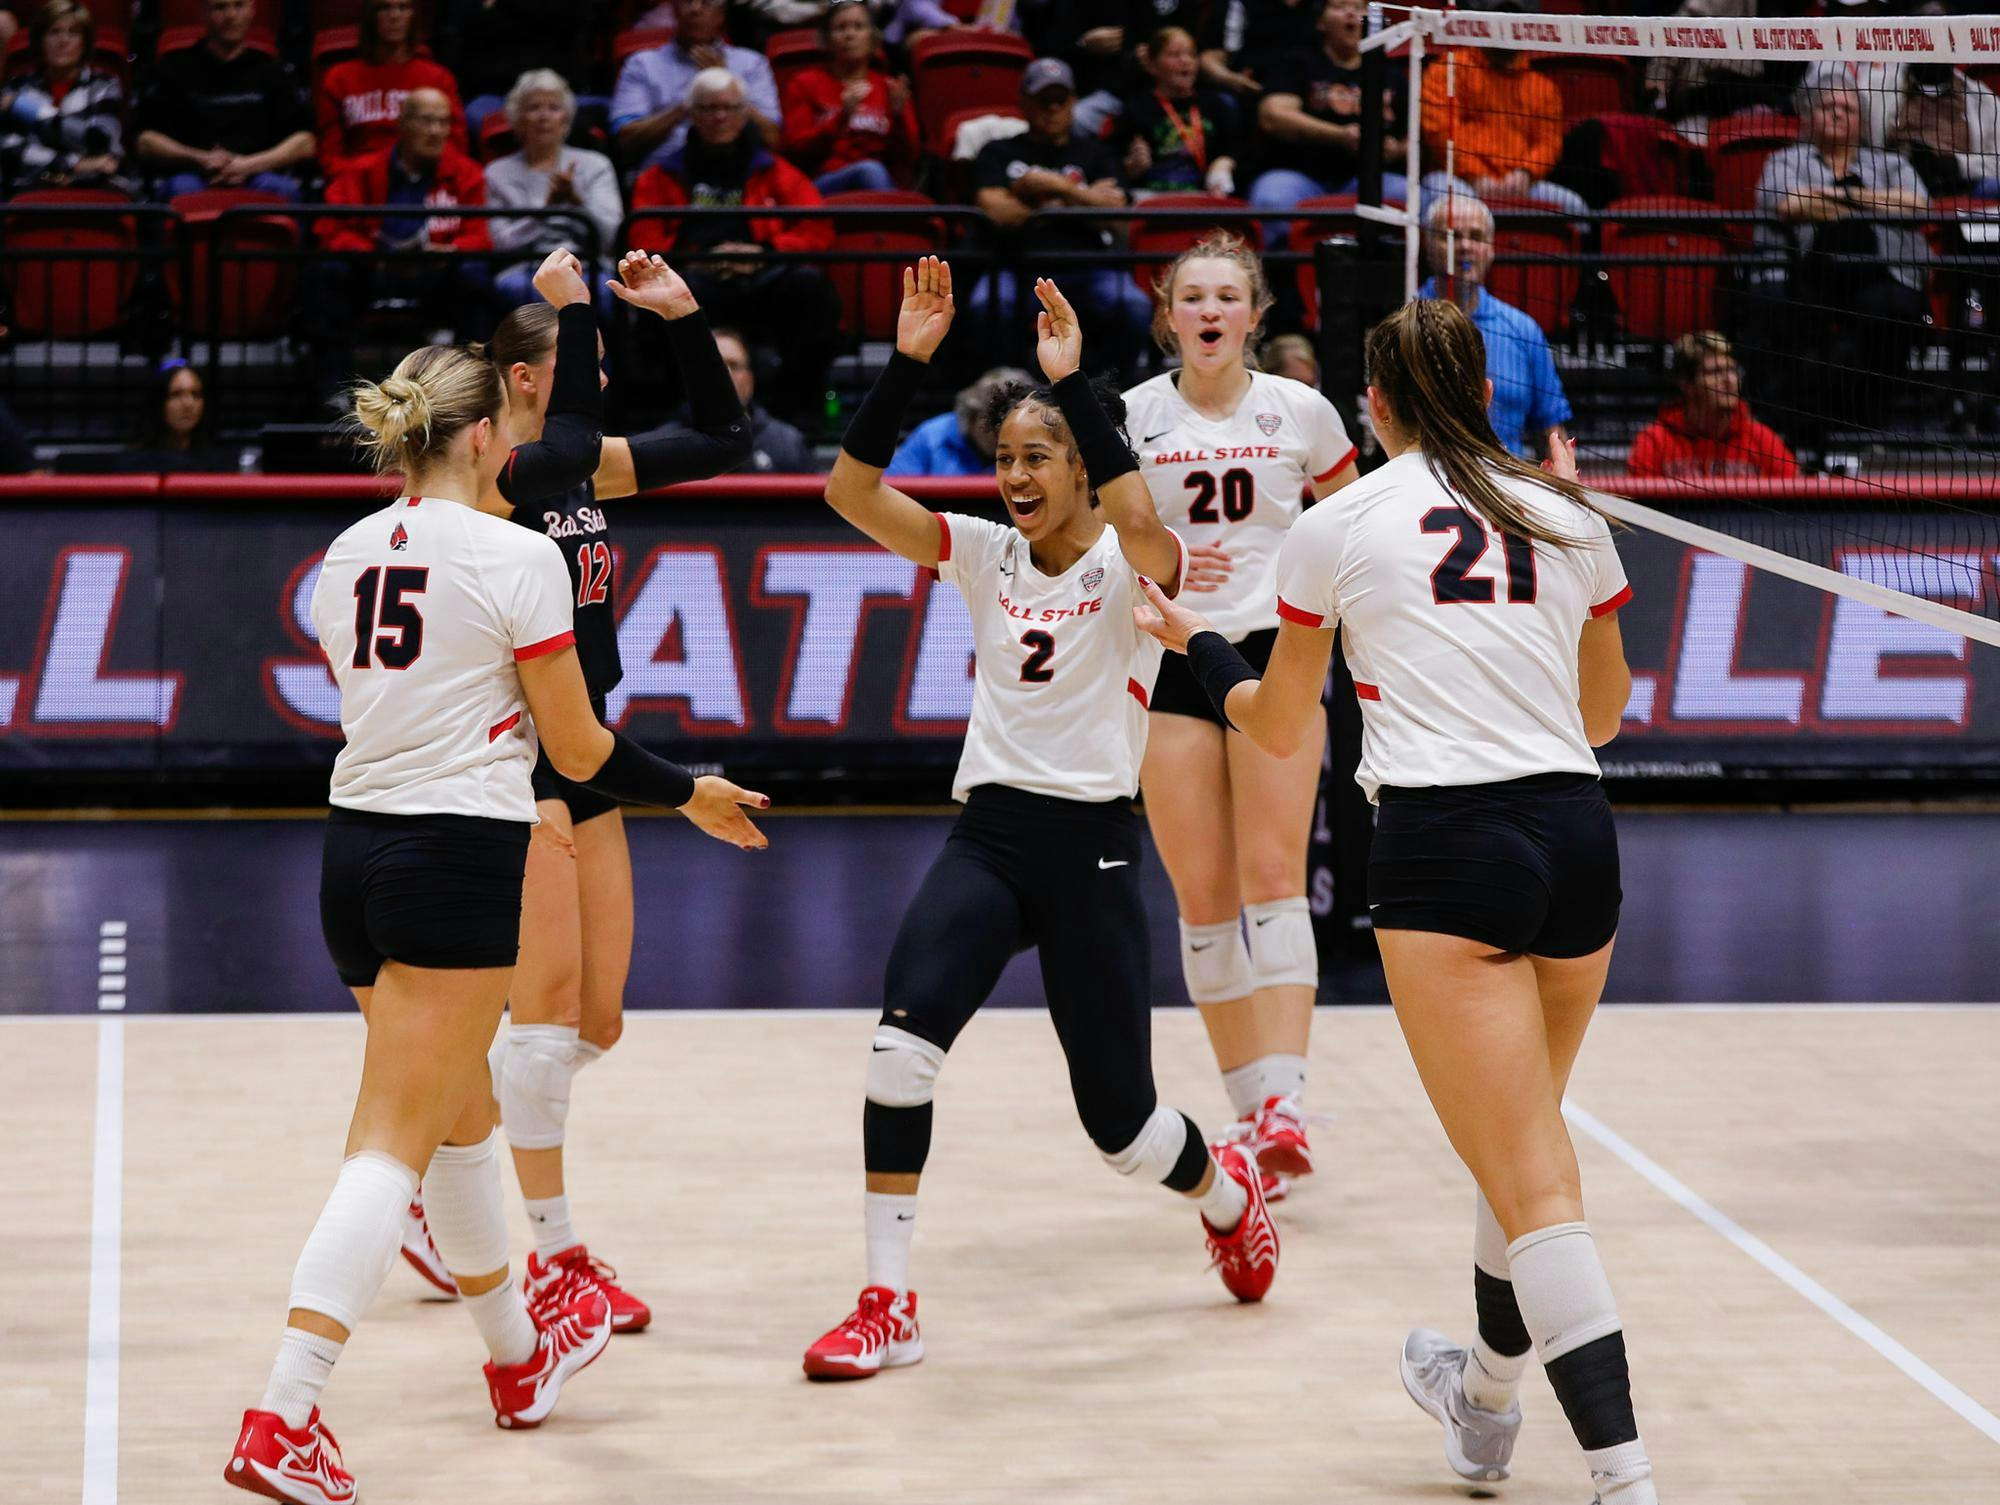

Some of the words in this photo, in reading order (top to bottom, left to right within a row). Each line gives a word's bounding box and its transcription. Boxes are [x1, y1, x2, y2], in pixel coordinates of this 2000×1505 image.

[1969, 27, 1989, 51] BALL
[1155, 449, 1208, 465] BALL
[1214, 446, 1280, 460] STATE
[1184, 467, 1254, 524] 20
[577, 541, 612, 608] 12
[1418, 506, 1538, 605] 21
[352, 566, 430, 671] 15
[1019, 628, 1055, 683] 2
